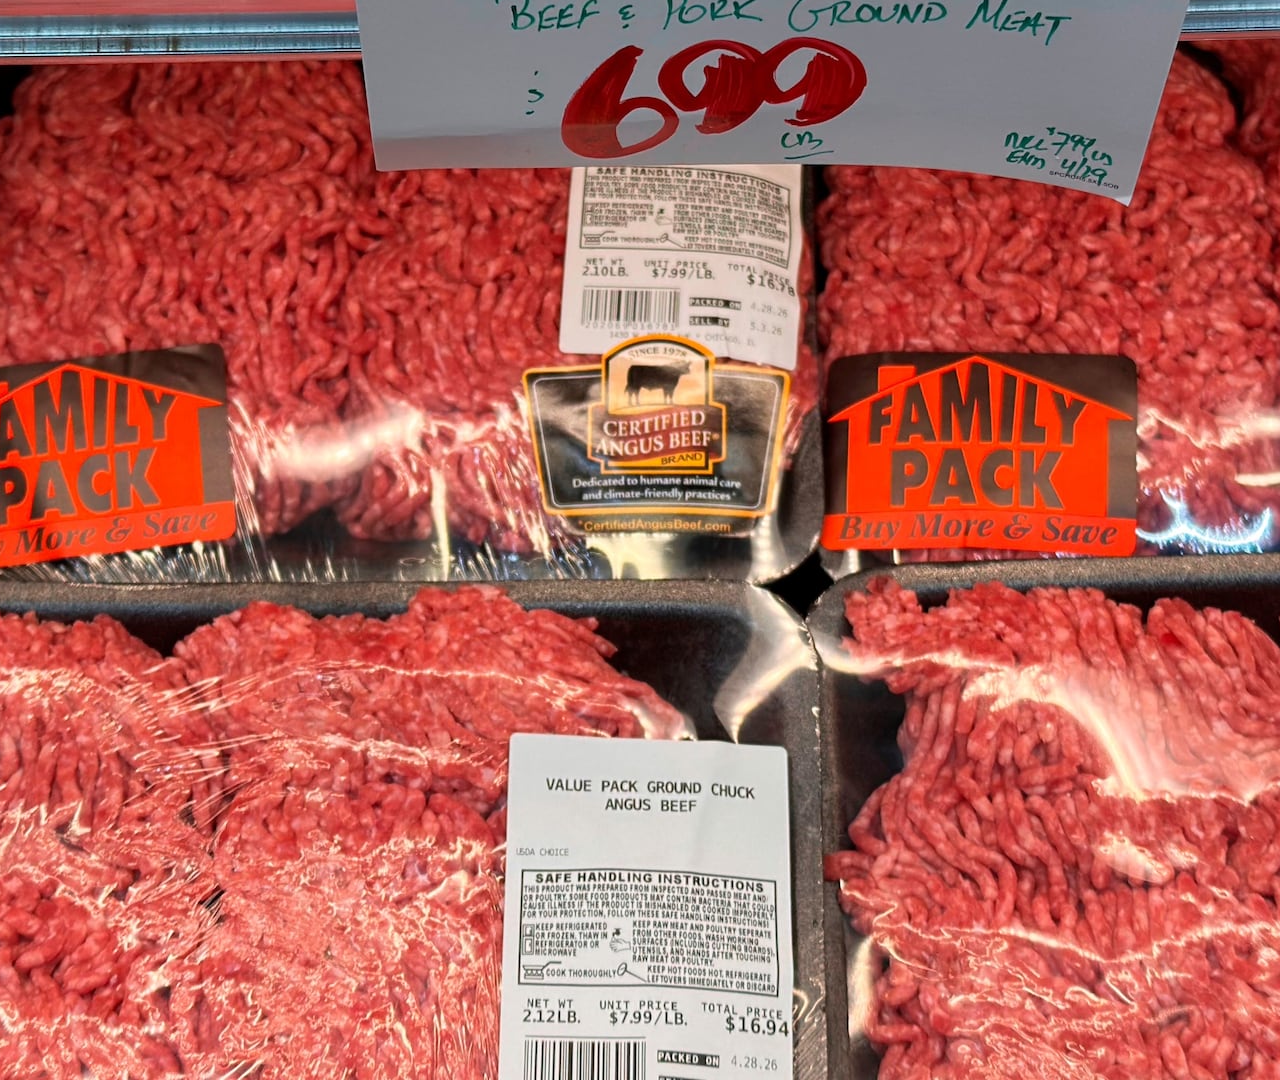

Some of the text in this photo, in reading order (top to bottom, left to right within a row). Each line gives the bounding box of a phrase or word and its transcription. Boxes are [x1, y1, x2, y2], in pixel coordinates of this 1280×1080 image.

[746, 274, 796, 297] $16.78
[868, 363, 1087, 446] FAMILY
[603, 410, 705, 437] CERTIFIED
[595, 431, 712, 456] ANGUS BEEF
[661, 453, 703, 465] BRAND
[573, 476, 741, 489] Dedicated to humane animal care
[890, 448, 1065, 510] PACK
[583, 490, 601, 500] and
[604, 489, 683, 501] climate-friendly
[14, 523, 98, 555] More
[105, 517, 134, 543] &
[142, 510, 218, 538] Save
[840, 512, 1119, 545] Buy More & Save
[545, 777, 755, 799] VALUE PACK GROUND CHUCK
[605, 798, 697, 813] ANGUS BEEF
[516, 848, 569, 857] USDA CHOICE
[536, 873, 764, 893] SAFE HANDLING INSTRUCTIONS
[523, 1009, 789, 1037] 2.12LB. $7.99/LB. $16.94
[657, 1052, 778, 1071] PACKED ON 4.28.26
